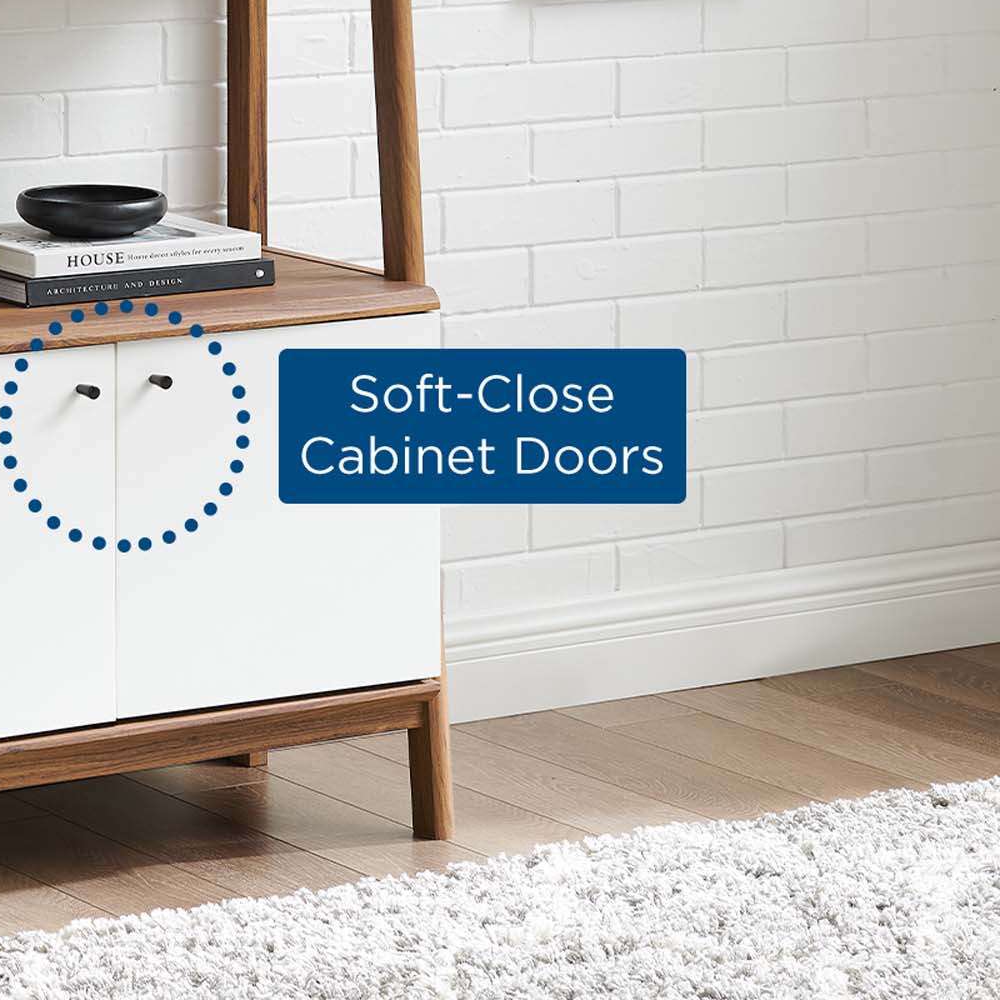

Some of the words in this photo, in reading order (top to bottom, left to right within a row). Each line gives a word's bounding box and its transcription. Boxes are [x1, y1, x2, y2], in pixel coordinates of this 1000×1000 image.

[67, 251, 125, 268] HOUSE
[46, 283, 120, 296] ARCHITECTURE
[124, 280, 144, 290] AND
[149, 277, 183, 288] DESIGN
